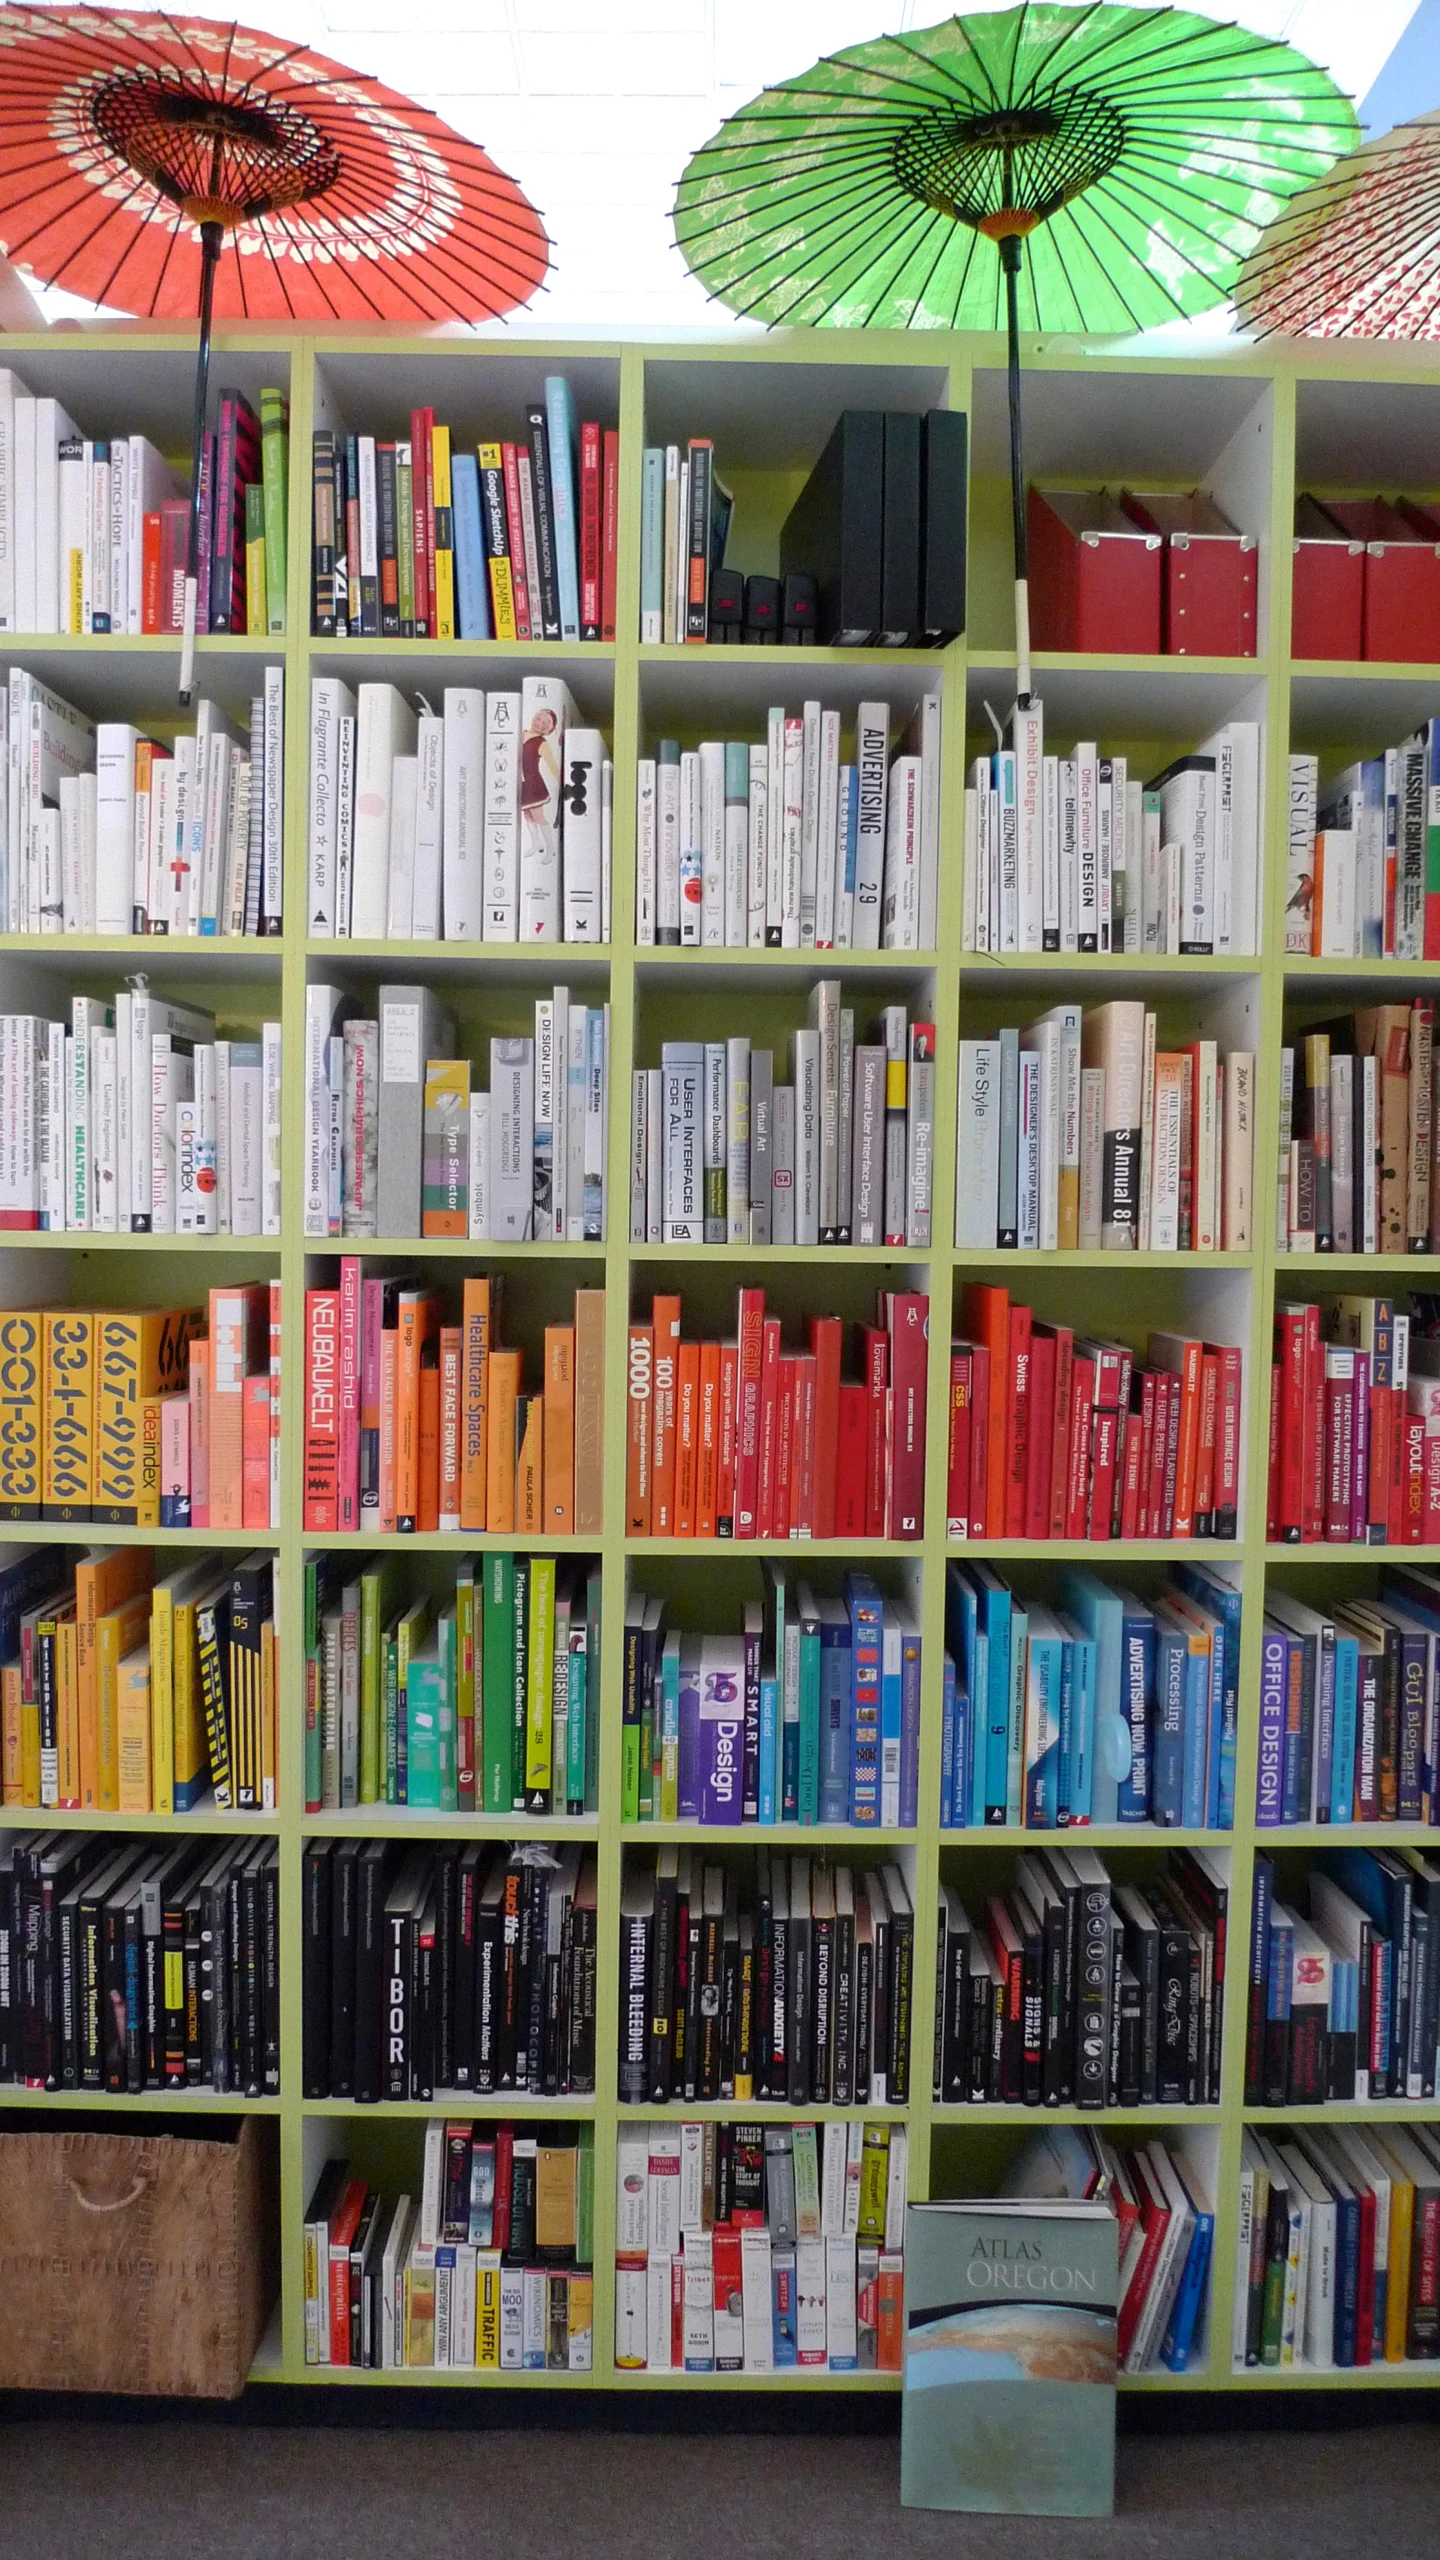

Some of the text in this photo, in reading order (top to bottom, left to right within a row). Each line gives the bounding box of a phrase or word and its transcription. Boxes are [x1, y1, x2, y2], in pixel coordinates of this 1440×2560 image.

[112, 456, 123, 506] TACTICS
[487, 470, 503, 555] Google SketchUp
[112, 515, 122, 548] HOPE
[172, 570, 184, 627] MOMENTS
[495, 568, 510, 624] DUMMIES
[32, 740, 40, 781] BUILDING
[267, 684, 278, 902] The Best of Newspaper Design 30th Edition
[316, 693, 330, 887] In Flagrante Collecto KARP
[860, 728, 884, 834] ADVERTISING
[1024, 720, 1039, 816] Exhibit Design
[642, 805, 653, 894] Why Most Things Fail
[1003, 809, 1016, 889] BUZZMARKETING
[1081, 769, 1094, 907] Office Furniture DESIGN
[1289, 764, 1309, 856] VISUAL
[1404, 753, 1423, 879] MASSIVE CHANGE
[541, 1019, 551, 1118] DESIGN LIFE NOW
[669, 1078, 681, 1142] FOR ALL
[825, 1003, 837, 1146] Design Secrets: Furniture
[75, 1010, 85, 1219] UNDERSTANDING HEALTHCARE
[153, 1064, 166, 1208] How Doctors Think
[635, 1076, 644, 1165] Emotional Design
[683, 1078, 695, 1214] USER INTERFACES
[859, 1062, 875, 1217] Software User Interface Design
[1112, 1032, 1136, 1227] Art Directors Annual 81
[1157, 1089, 1168, 1204] INTERACTION DESIGN
[1168, 1090, 1178, 1196] THE ESSENTIALS OF
[447, 1125, 459, 1210] Type Selector
[913, 1122, 930, 1215] Re-imagine!
[311, 1298, 334, 1433] NEUBAUWELT
[342, 1268, 356, 1409] karim rashid
[630, 1337, 650, 1399] 1000
[656, 1357, 673, 1388] 100
[872, 1343, 886, 1398] lovemarks
[1016, 1355, 1028, 1392] Swiss
[1, 1319, 36, 1496] 001-333
[53, 1320, 88, 1497] 334-666
[102, 1321, 137, 1500] 667-999
[465, 1314, 486, 1456] Healthcare Spaces
[664, 1391, 674, 1427] years of
[702, 1383, 713, 1447] Do you matter?
[743, 1311, 761, 1456] SIGN GRAPHICS
[143, 1405, 160, 1489] ideaindex
[655, 1391, 665, 1467] magazine covers
[1098, 1421, 1110, 1466] Inspired
[1333, 1417, 1341, 1465] SOFTWARE
[1342, 1394, 1351, 1505] EFFECTIVE PROTOTYPING
[1408, 1426, 1425, 1514] layoutindex
[1332, 1467, 1340, 1502] MAKERS
[494, 1559, 502, 1603] WAYSHOWING
[343, 1612, 356, 1652] OFFICES
[43, 1637, 51, 1747] disruption
[747, 1687, 758, 1755] SMART
[763, 1719, 771, 1737] aid
[1129, 1637, 1146, 1796] ADVERTISING NOW. PRINT
[1164, 1648, 1183, 1731] Processing
[1260, 1644, 1282, 1805] OFFICE DESIGN
[1321, 1655, 1333, 1759] Designing Interfaces
[1403, 1662, 1423, 1787] GUI Bloopers
[710, 1722, 738, 1802] Design
[944, 1716, 954, 1776] PHOTOGRAPHY
[1361, 1678, 1376, 1800] THE ORGANIZATION MAN
[1034, 1780, 1045, 1806] Mayhew
[27, 1905, 41, 1951] Mapping
[62, 1916, 72, 2040] SECURITY DATA VISUALIZATION
[88, 1925, 98, 2056] Information Visualization
[188, 1961, 197, 2042] HUMAN INTERACTIONS
[390, 1919, 404, 2063] TIBOR
[481, 1942, 493, 2060] Experimentation Matters
[628, 1923, 645, 2061] INTERNAL BLEEDING
[817, 1944, 828, 2044] BEYOND DISRUPTION
[1010, 1958, 1020, 2020] WARNING
[1025, 1996, 1033, 2047] SIGNALS
[1033, 1997, 1041, 2047] SIGNS &
[705, 2122, 713, 2137] THE
[705, 2140, 713, 2164] TALENT
[869, 2160, 881, 2208] groundswell
[512, 2222, 524, 2249] WAR
[967, 2261, 1097, 2292] OREGON
[970, 2237, 1042, 2260] ATLAS
[533, 2276, 542, 2337] WIKINOMICS
[779, 2273, 789, 2309] SWITCH
[481, 2308, 494, 2361] TRAFFIC
